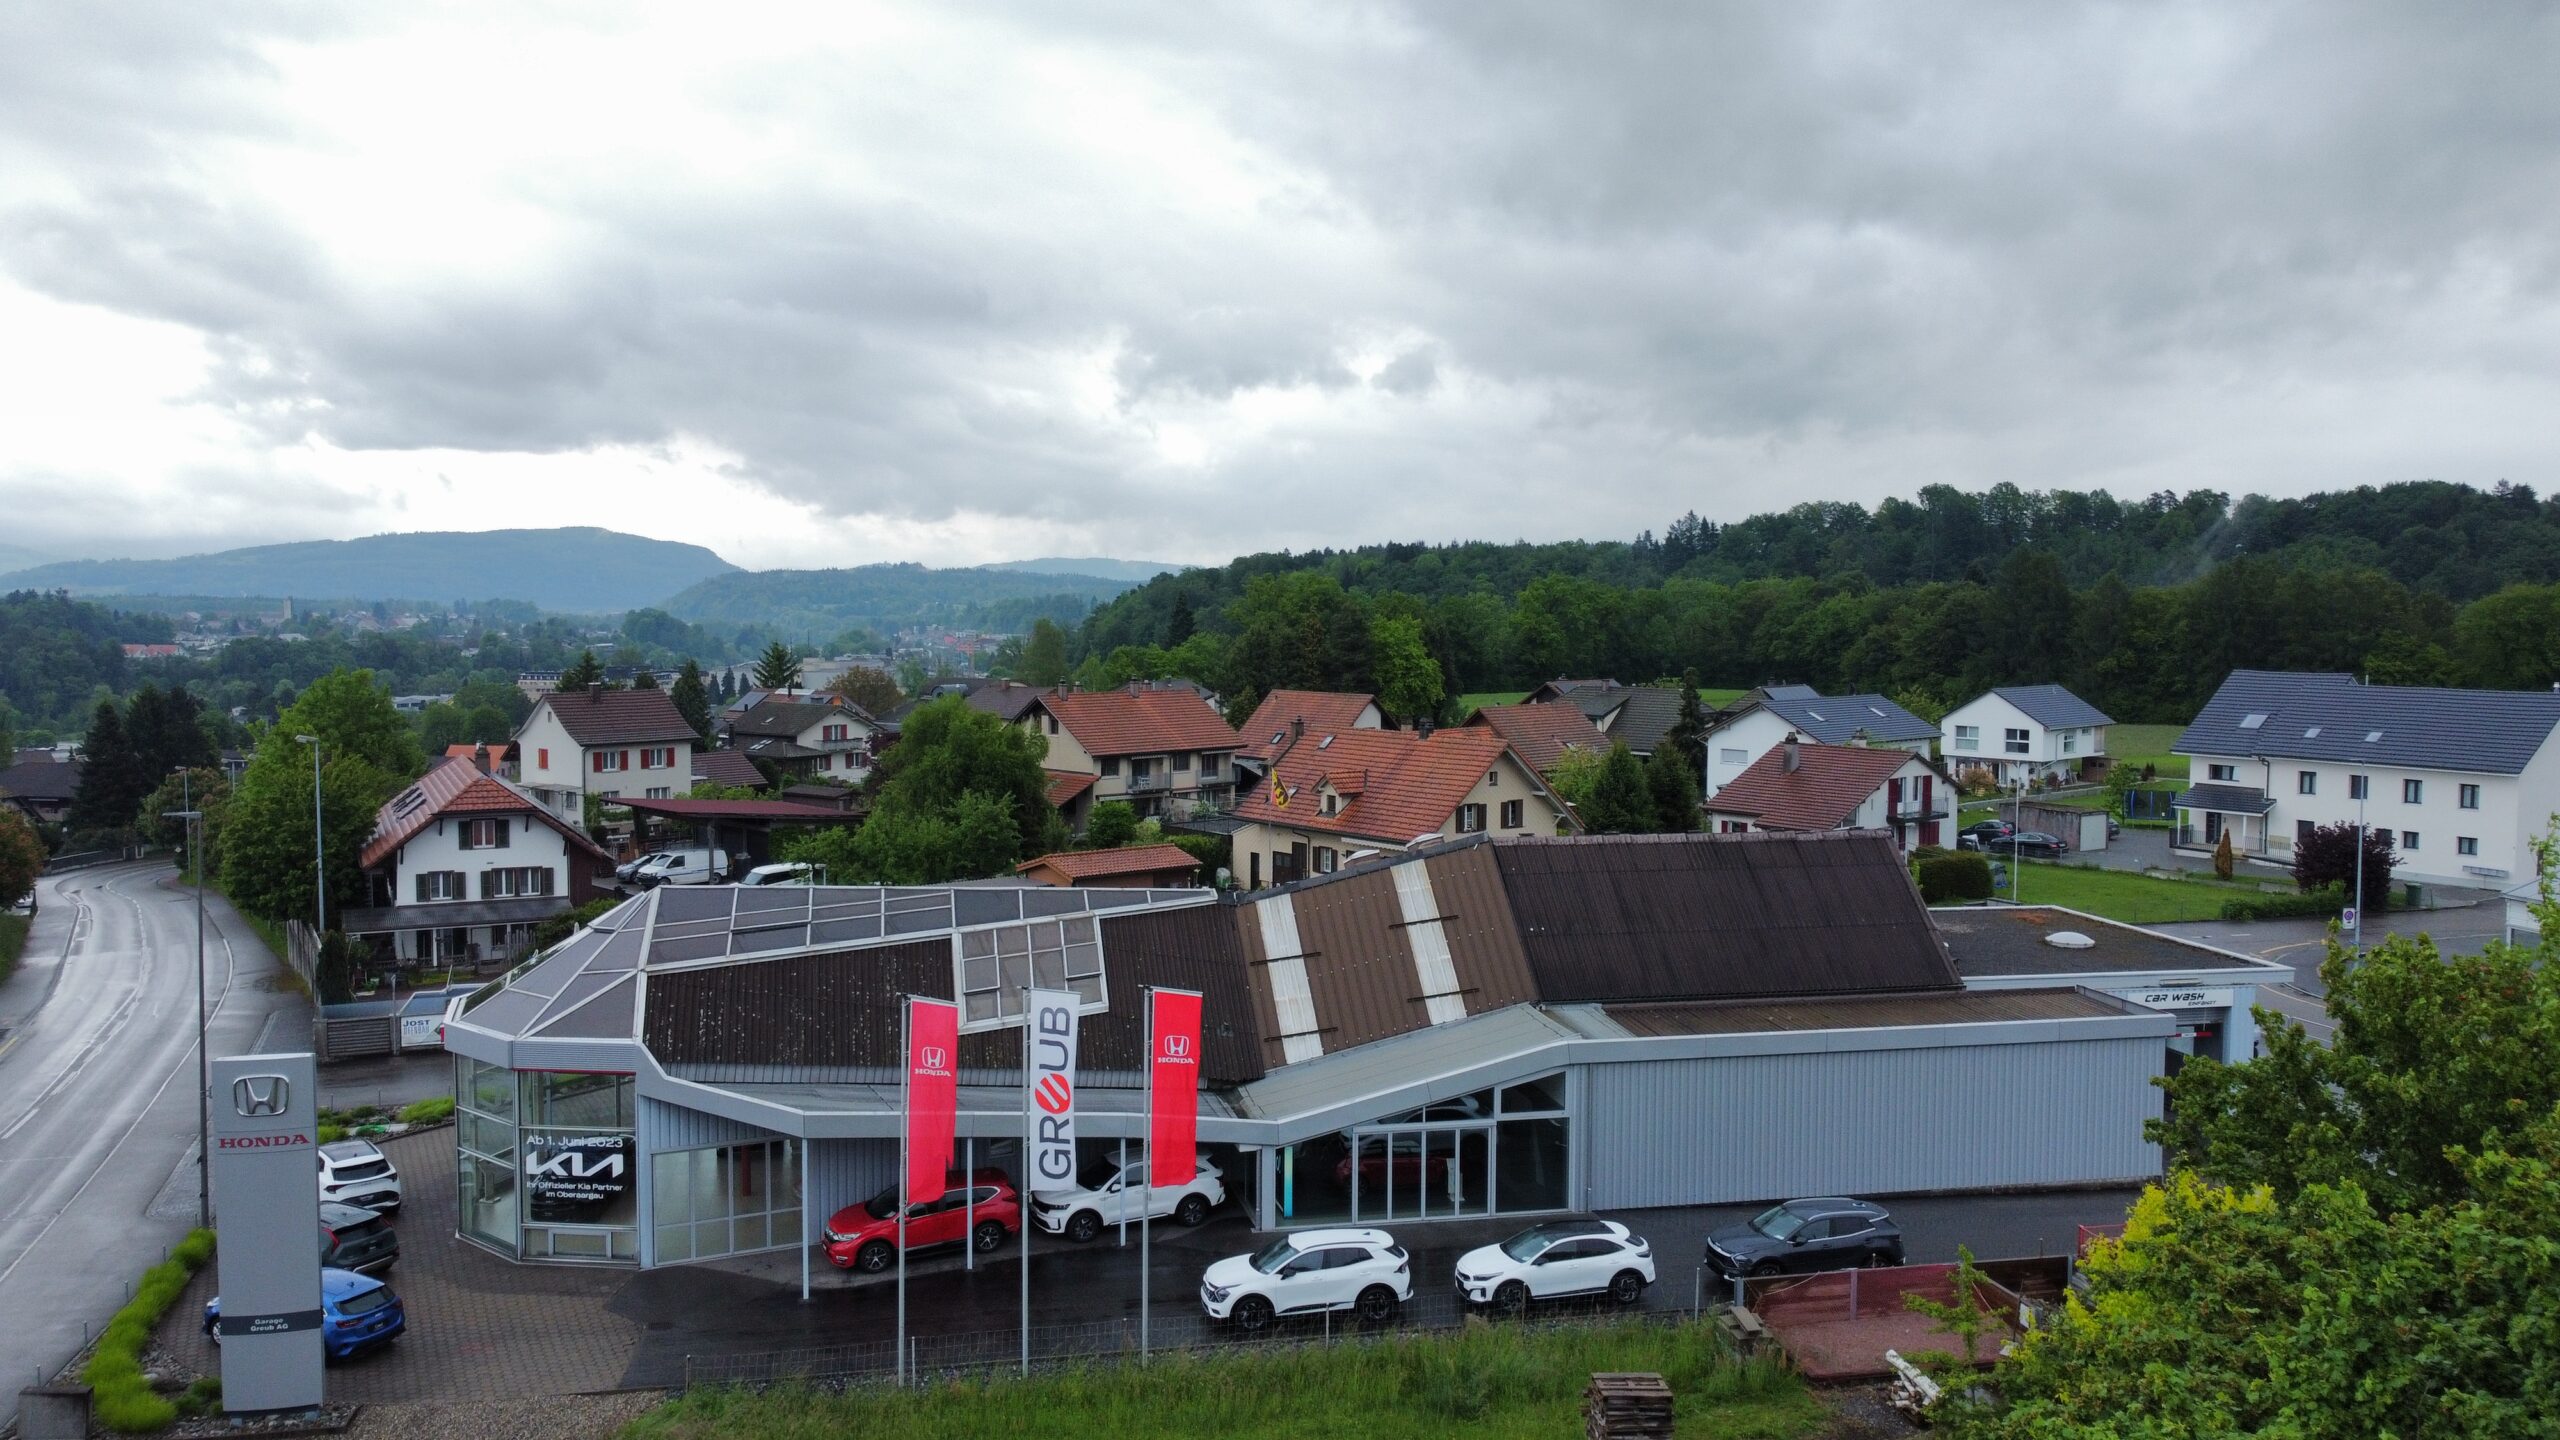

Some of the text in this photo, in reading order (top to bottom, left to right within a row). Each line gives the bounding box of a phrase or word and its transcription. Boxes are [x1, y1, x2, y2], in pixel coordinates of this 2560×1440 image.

[914, 1068, 951, 1077] HONDA
[218, 1134, 310, 1149] HONDA
[526, 1135, 623, 1148] Ab 1. Juni 2023
[526, 1151, 623, 1178] KIA
[526, 1181, 537, 1189] Ihr
[538, 1182, 576, 1190] Offizieller
[593, 1183, 623, 1191] Partner
[557, 1191, 604, 1200] Oberaargau
